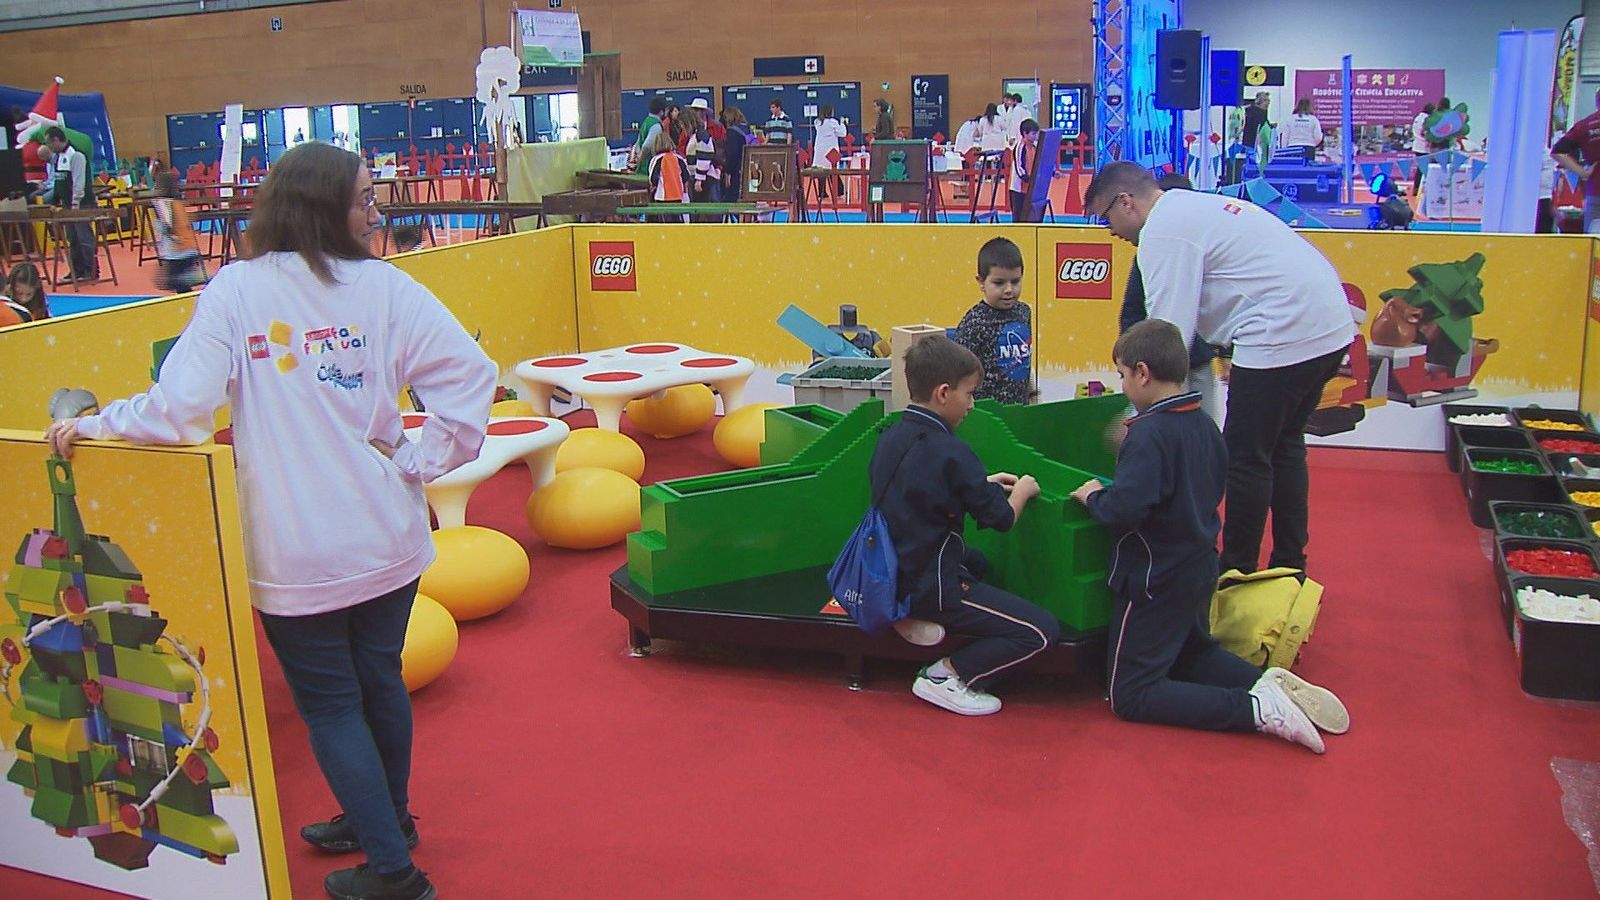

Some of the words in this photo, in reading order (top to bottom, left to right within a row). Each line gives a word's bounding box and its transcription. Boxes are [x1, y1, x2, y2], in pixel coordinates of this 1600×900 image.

[666, 70, 698, 82] SALIDA
[400, 84, 426, 94] SALIDA
[1313, 88, 1343, 96] ROBÓTIC
[593, 256, 632, 275] LEGO
[1060, 260, 1108, 281] LEGO
[1000, 344, 1032, 358] NAS
